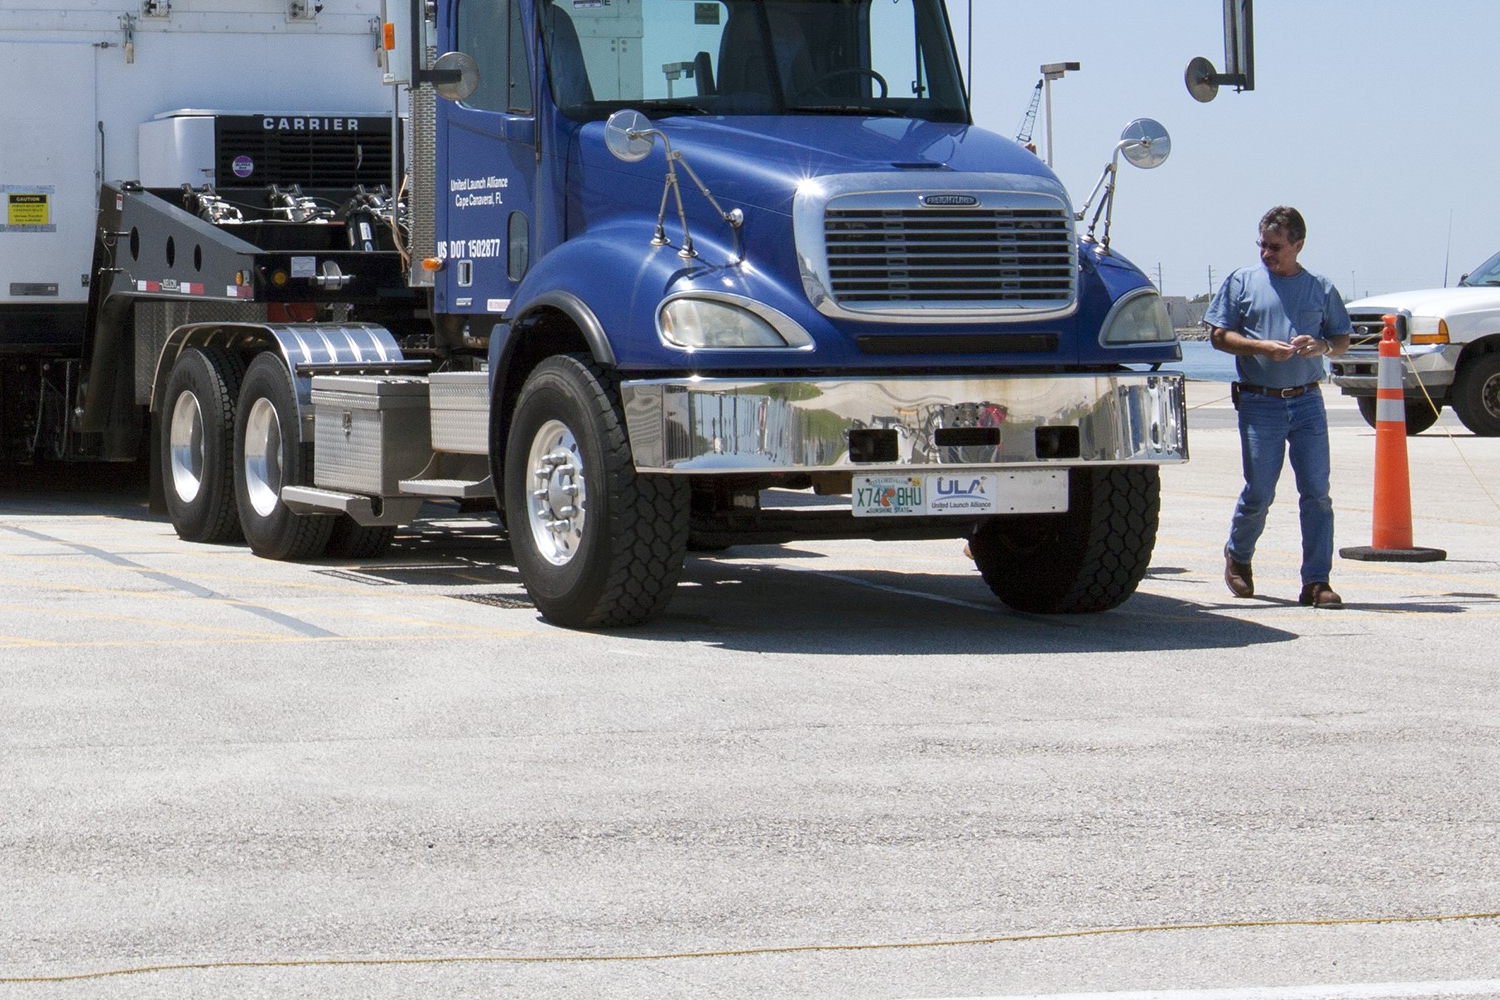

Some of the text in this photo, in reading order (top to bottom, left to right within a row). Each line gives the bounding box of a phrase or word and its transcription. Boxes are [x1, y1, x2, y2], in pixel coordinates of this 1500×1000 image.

[263, 117, 359, 130] CARRIER
[450, 176, 508, 191] United Launch Alliance
[455, 192, 503, 210] Cape Canaveral, FL
[926, 196, 975, 204] FREIGHTLINER
[437, 238, 500, 259] US DOT 1502877
[937, 479, 985, 495] ULA
[857, 487, 922, 507] X74 8HU
